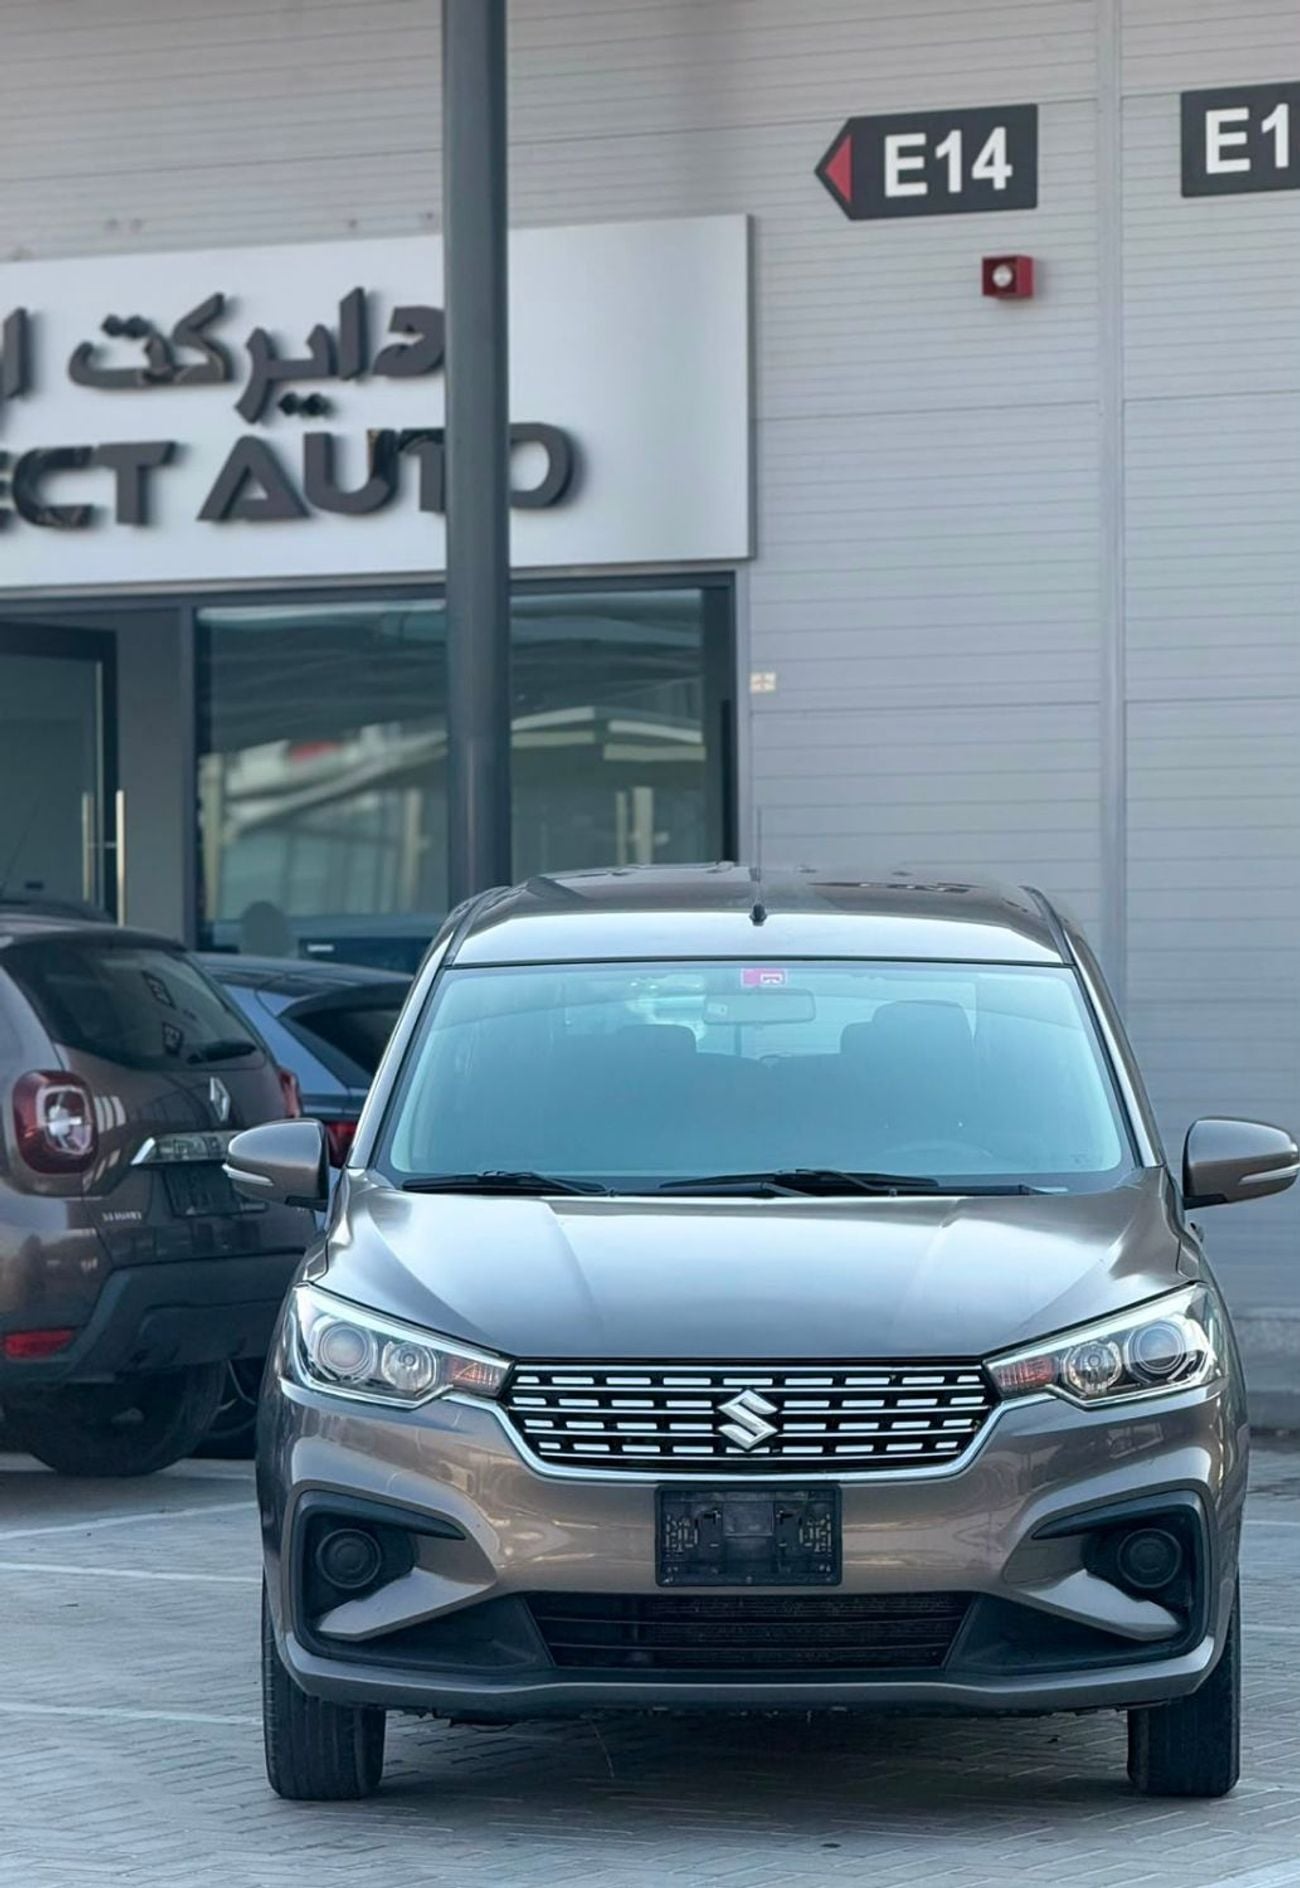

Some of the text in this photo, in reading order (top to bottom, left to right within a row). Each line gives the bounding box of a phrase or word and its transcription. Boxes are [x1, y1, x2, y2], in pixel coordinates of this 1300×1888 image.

[884, 126, 1013, 198] E14
[1206, 103, 1289, 174] E1
[0, 441, 178, 528] CT
